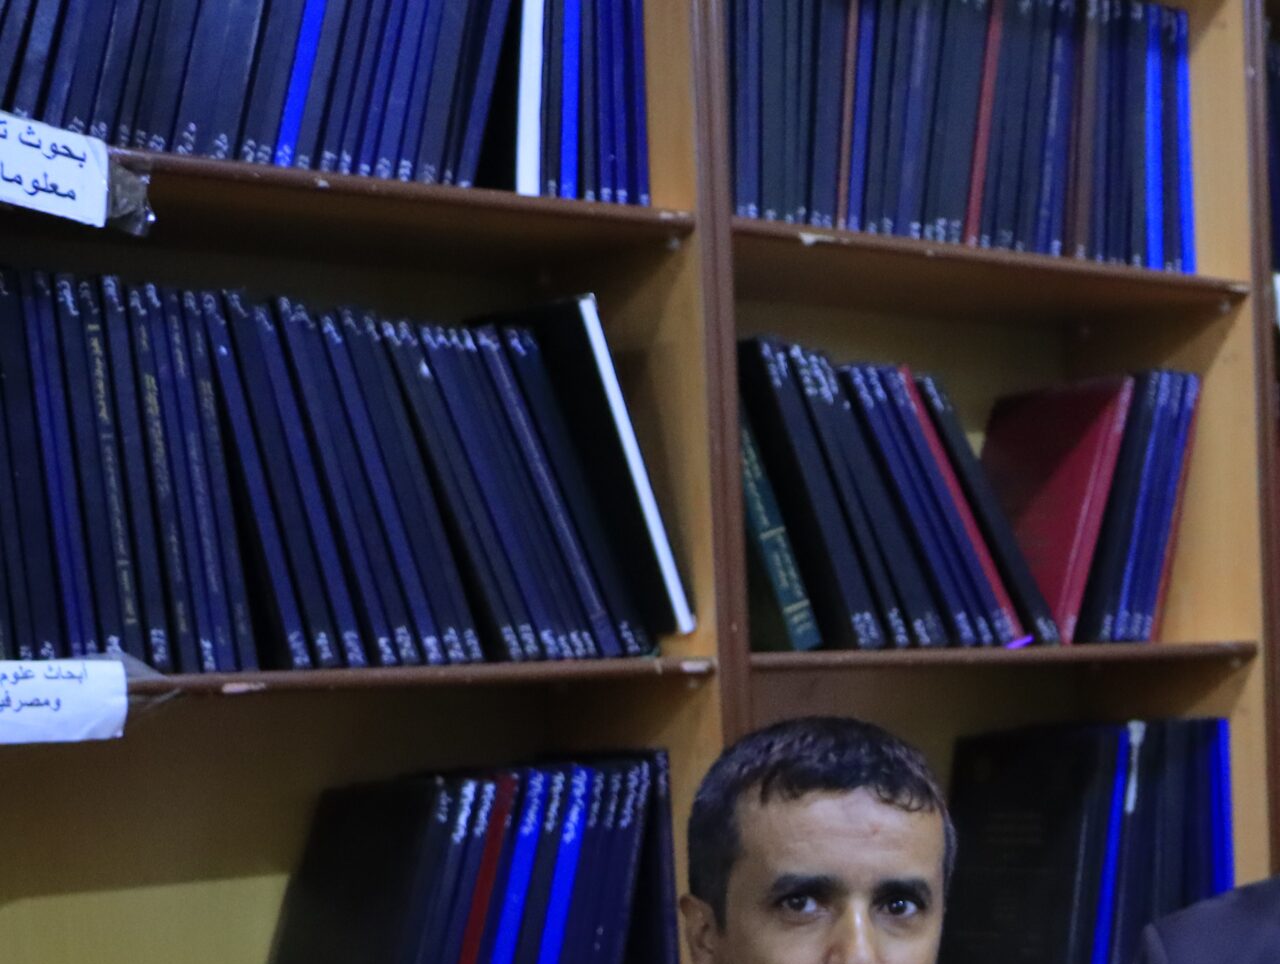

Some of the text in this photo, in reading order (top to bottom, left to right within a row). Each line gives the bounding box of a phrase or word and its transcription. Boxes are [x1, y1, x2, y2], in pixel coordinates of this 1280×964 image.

[16, 125, 87, 168] بحوث
[0, 160, 76, 201] معلوما
[0, 690, 61, 713] ومصرفي
